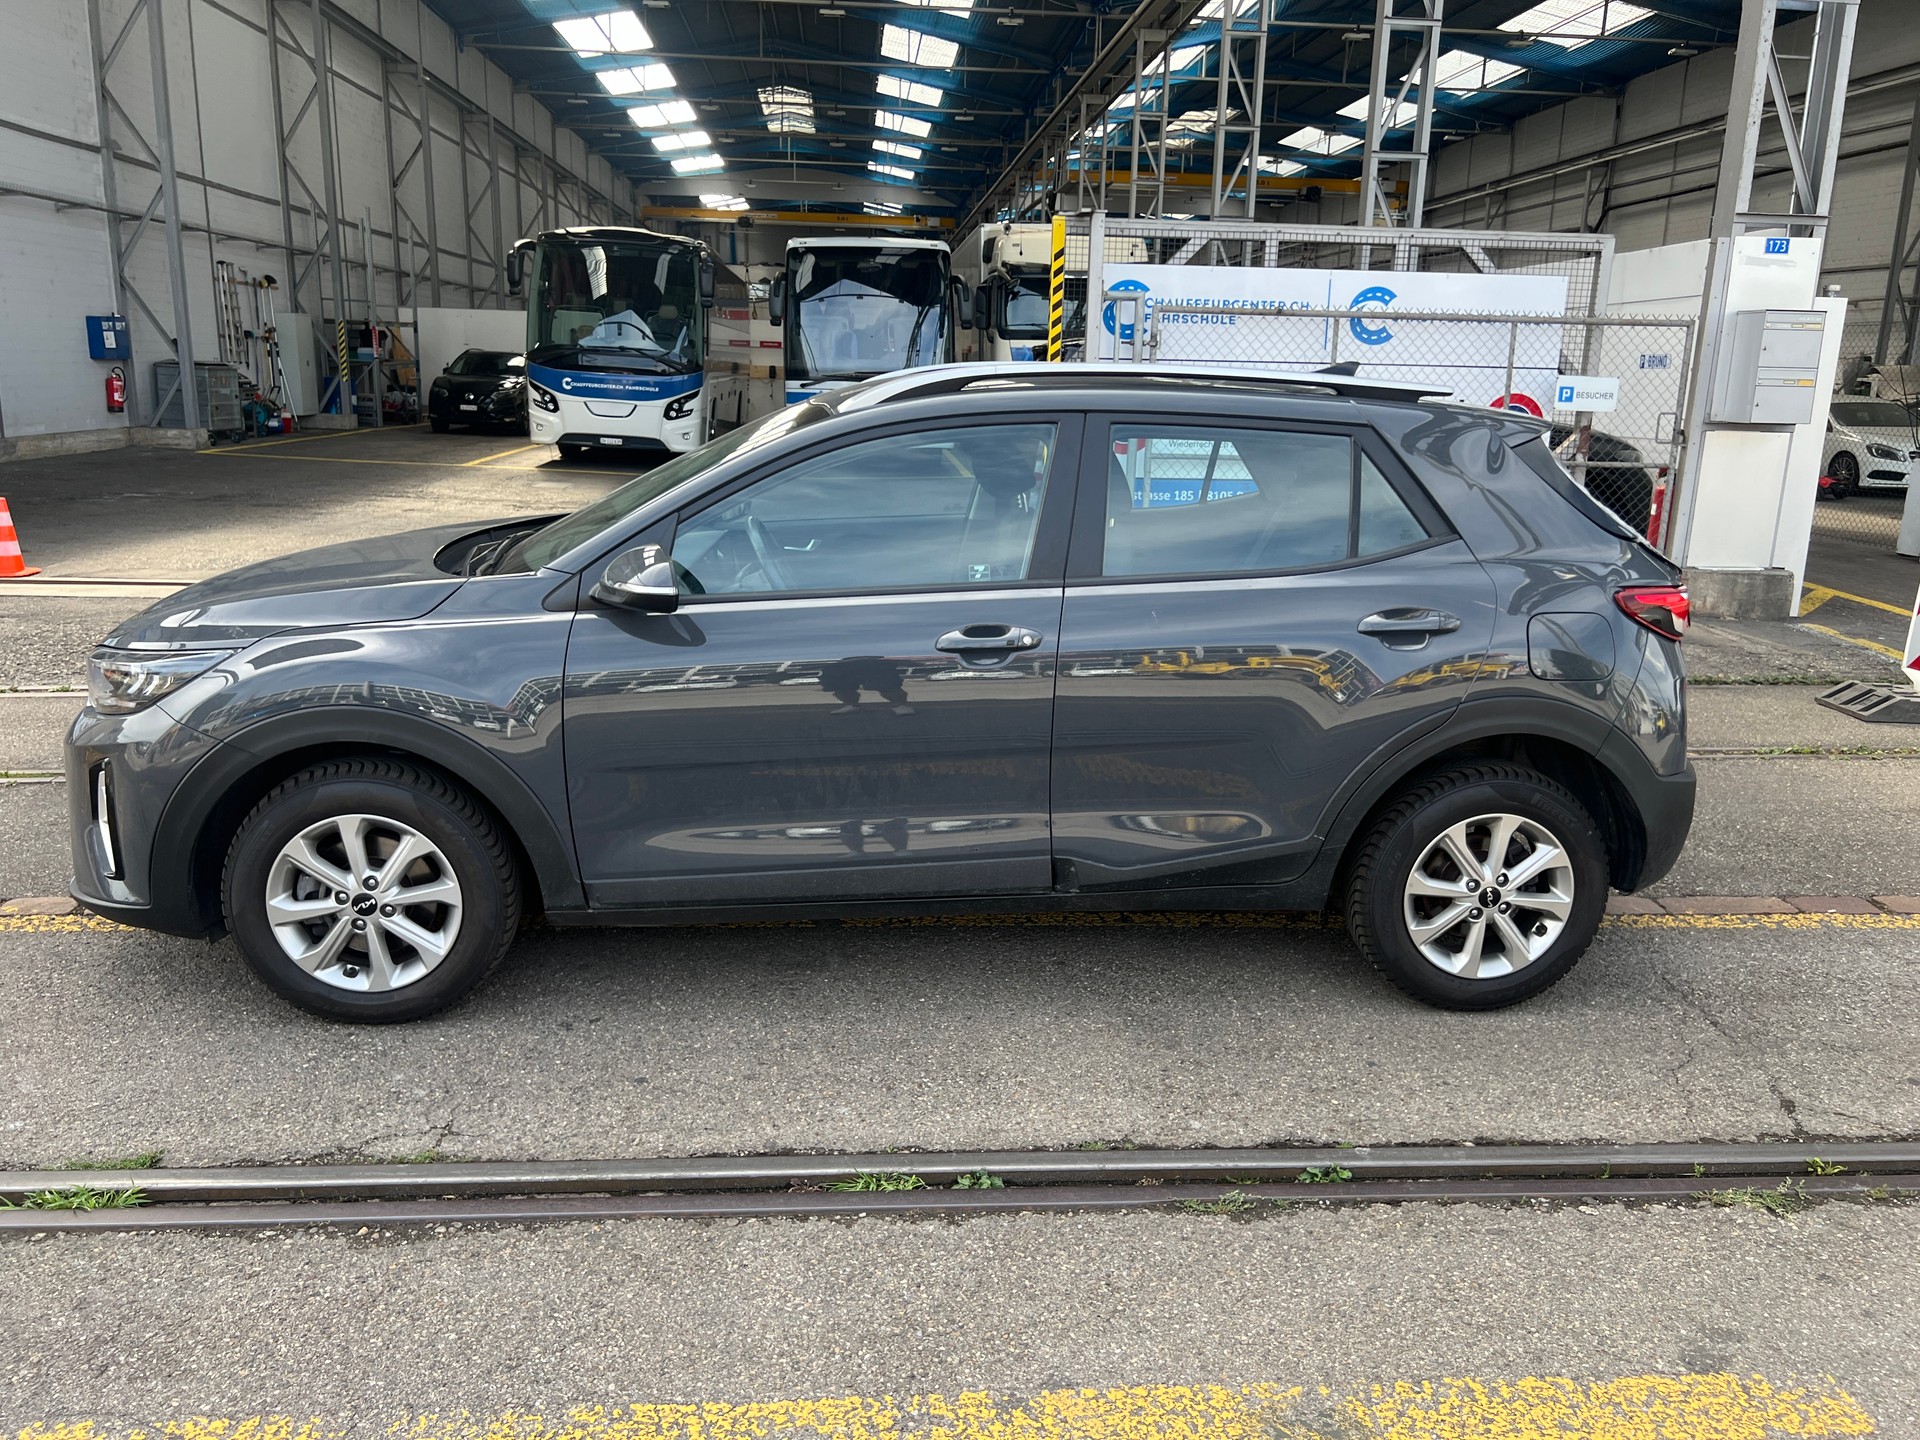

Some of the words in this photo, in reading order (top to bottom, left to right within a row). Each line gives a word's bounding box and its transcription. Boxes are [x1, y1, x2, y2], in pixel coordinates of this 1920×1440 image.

[1768, 240, 1787, 252] 173
[1145, 297, 1310, 311] CHAUFFEURCENTERCH
[1144, 313, 1236, 325] FHRSCHULE
[1575, 391, 1614, 400] BESUCHER
[1168, 440, 1213, 449] Wiederrech
[1133, 490, 1171, 501] stasse
[1174, 490, 1194, 501] 185
